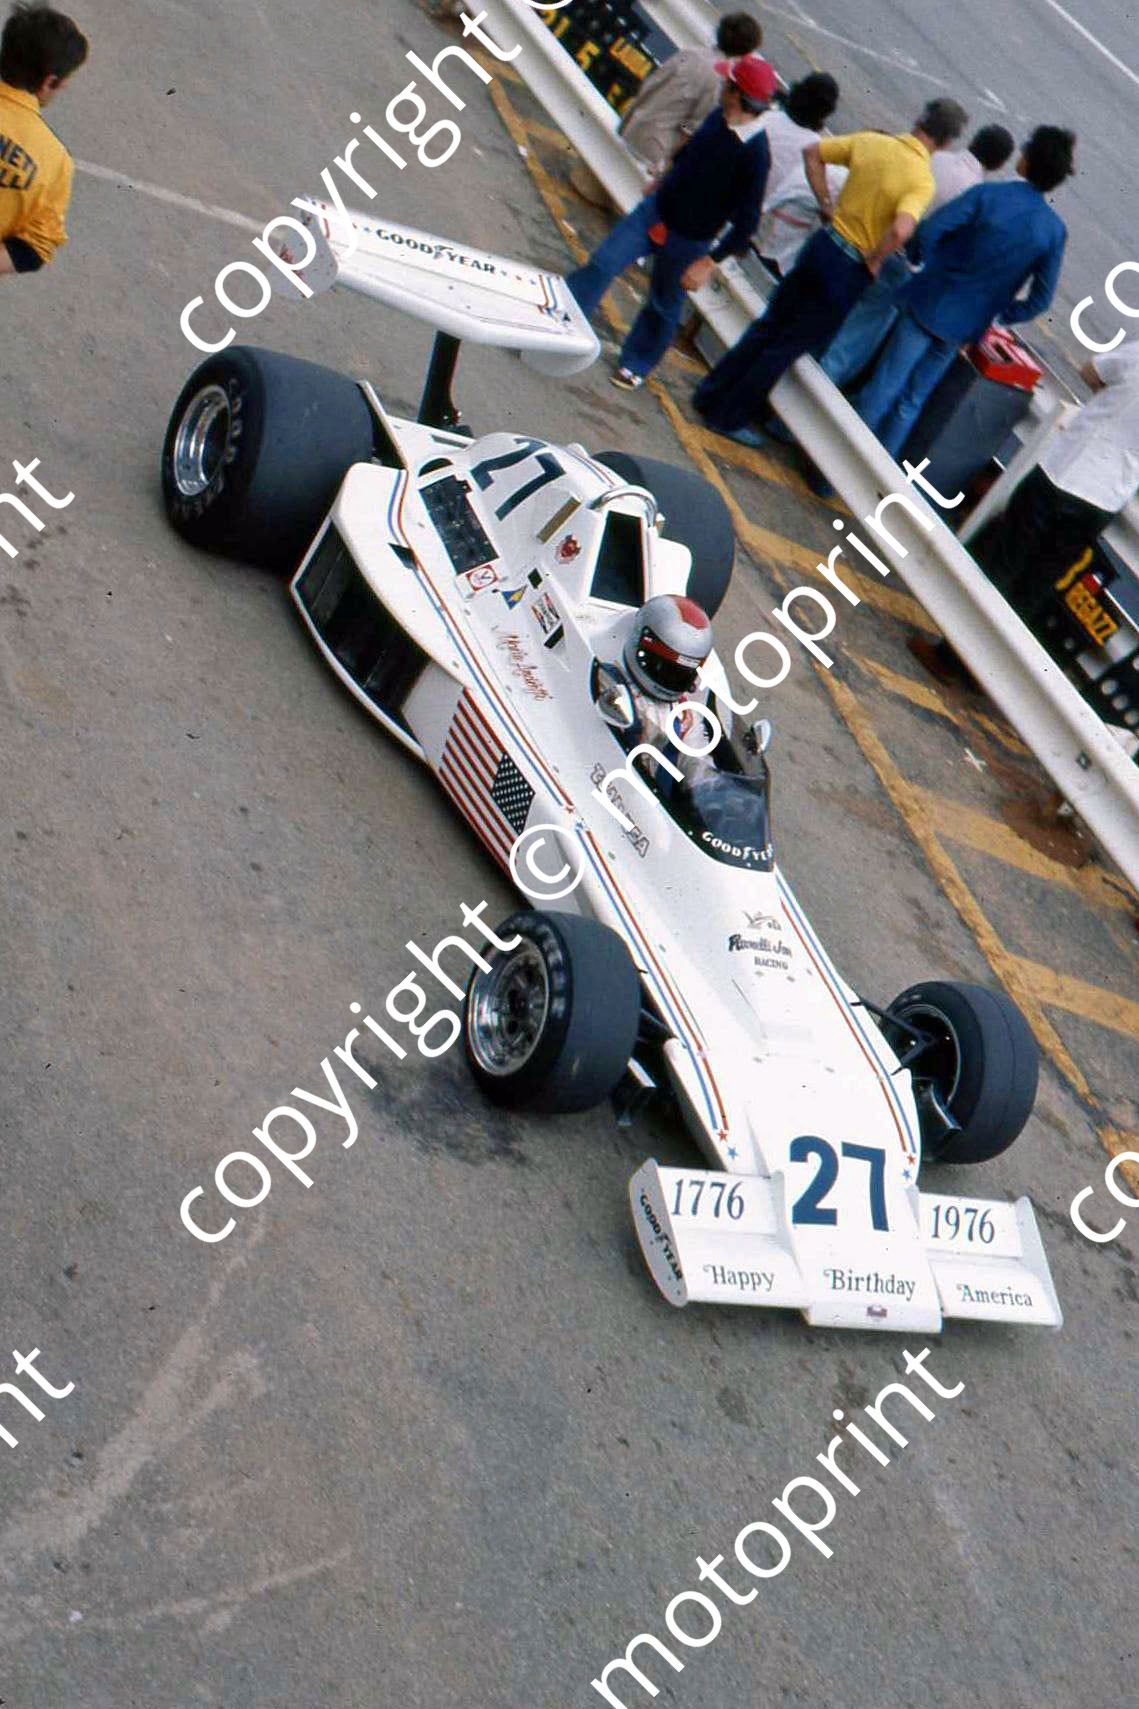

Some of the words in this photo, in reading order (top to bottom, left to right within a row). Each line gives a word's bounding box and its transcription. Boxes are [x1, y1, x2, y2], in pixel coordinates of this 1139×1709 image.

[376, 228, 496, 274] GOODYEAR
[469, 438, 567, 522] 27
[753, 956, 788, 970] RACING
[670, 1178, 745, 1221] 1776
[789, 1135, 890, 1232] 27
[639, 1194, 683, 1281] GOODYEAR
[930, 1203, 996, 1244] 1976
[703, 1264, 776, 1292] Happy
[823, 1268, 916, 1301] Birthday
[956, 1284, 1033, 1307] America
